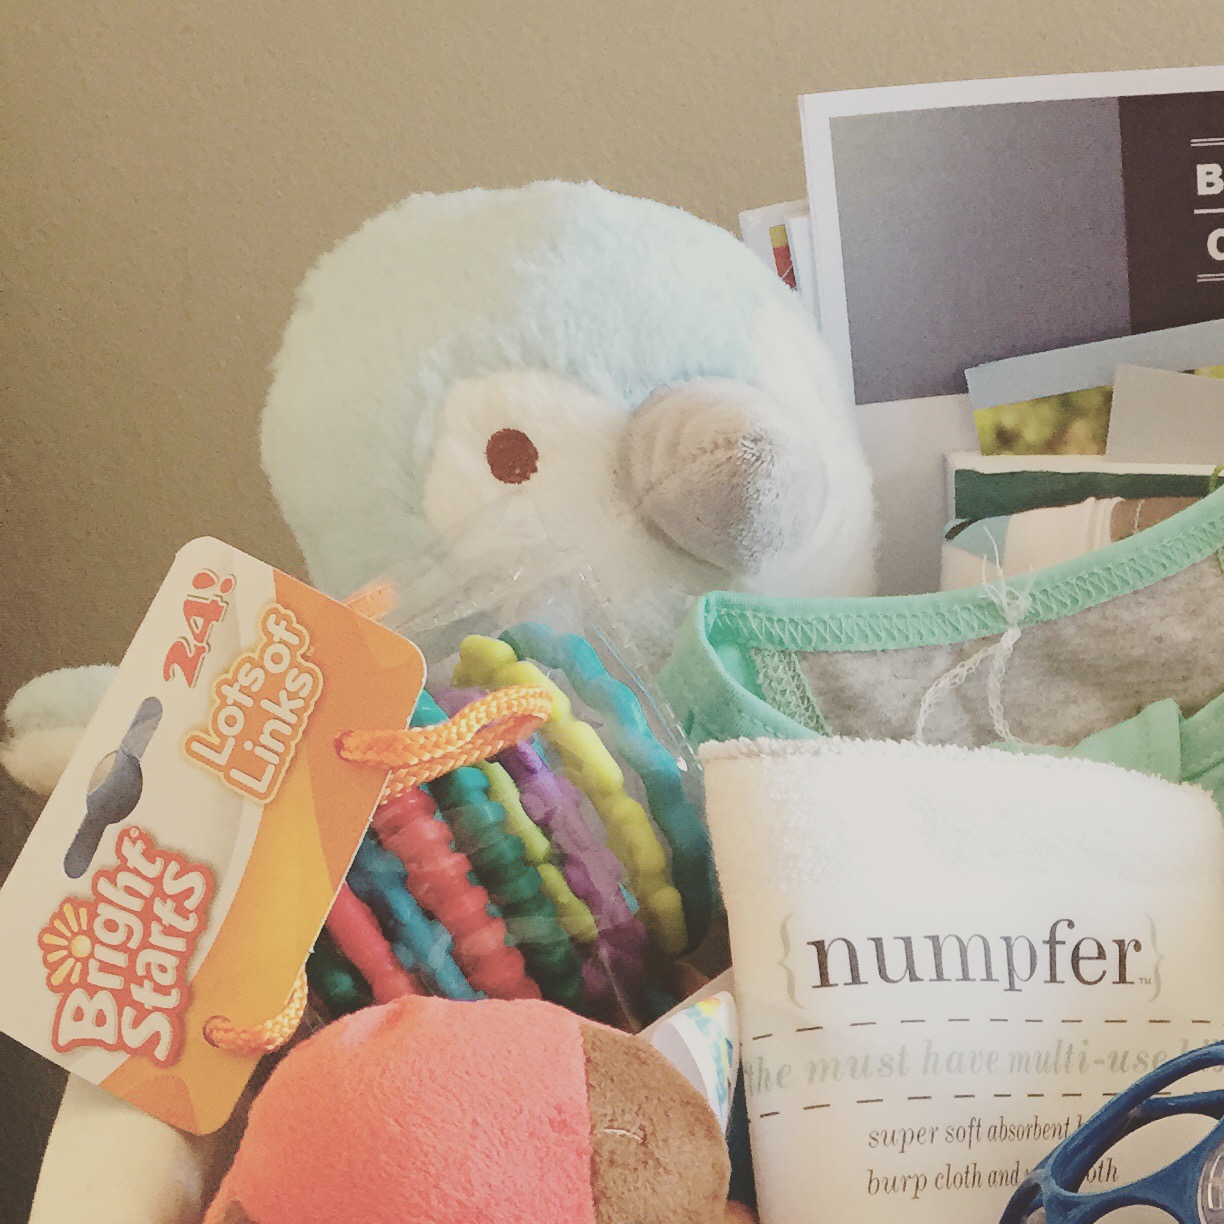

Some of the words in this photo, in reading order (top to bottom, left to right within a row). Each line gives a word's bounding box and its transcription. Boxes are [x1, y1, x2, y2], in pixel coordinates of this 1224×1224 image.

[190, 662, 266, 766] Lots
[262, 613, 301, 675] of
[229, 667, 314, 794] Links
[57, 836, 166, 1047] Bright
[120, 860, 207, 1062] Starts
[806, 1043, 909, 1086] must
[921, 1038, 1000, 1078] have
[1006, 1037, 1168, 1077] multi-use
[866, 1168, 928, 1199] burp
[933, 1162, 982, 1191] cloth
[987, 1160, 1020, 1187] and
[867, 1124, 941, 1154] super
[944, 1116, 983, 1150] soft
[986, 1114, 1071, 1143] absorbent
